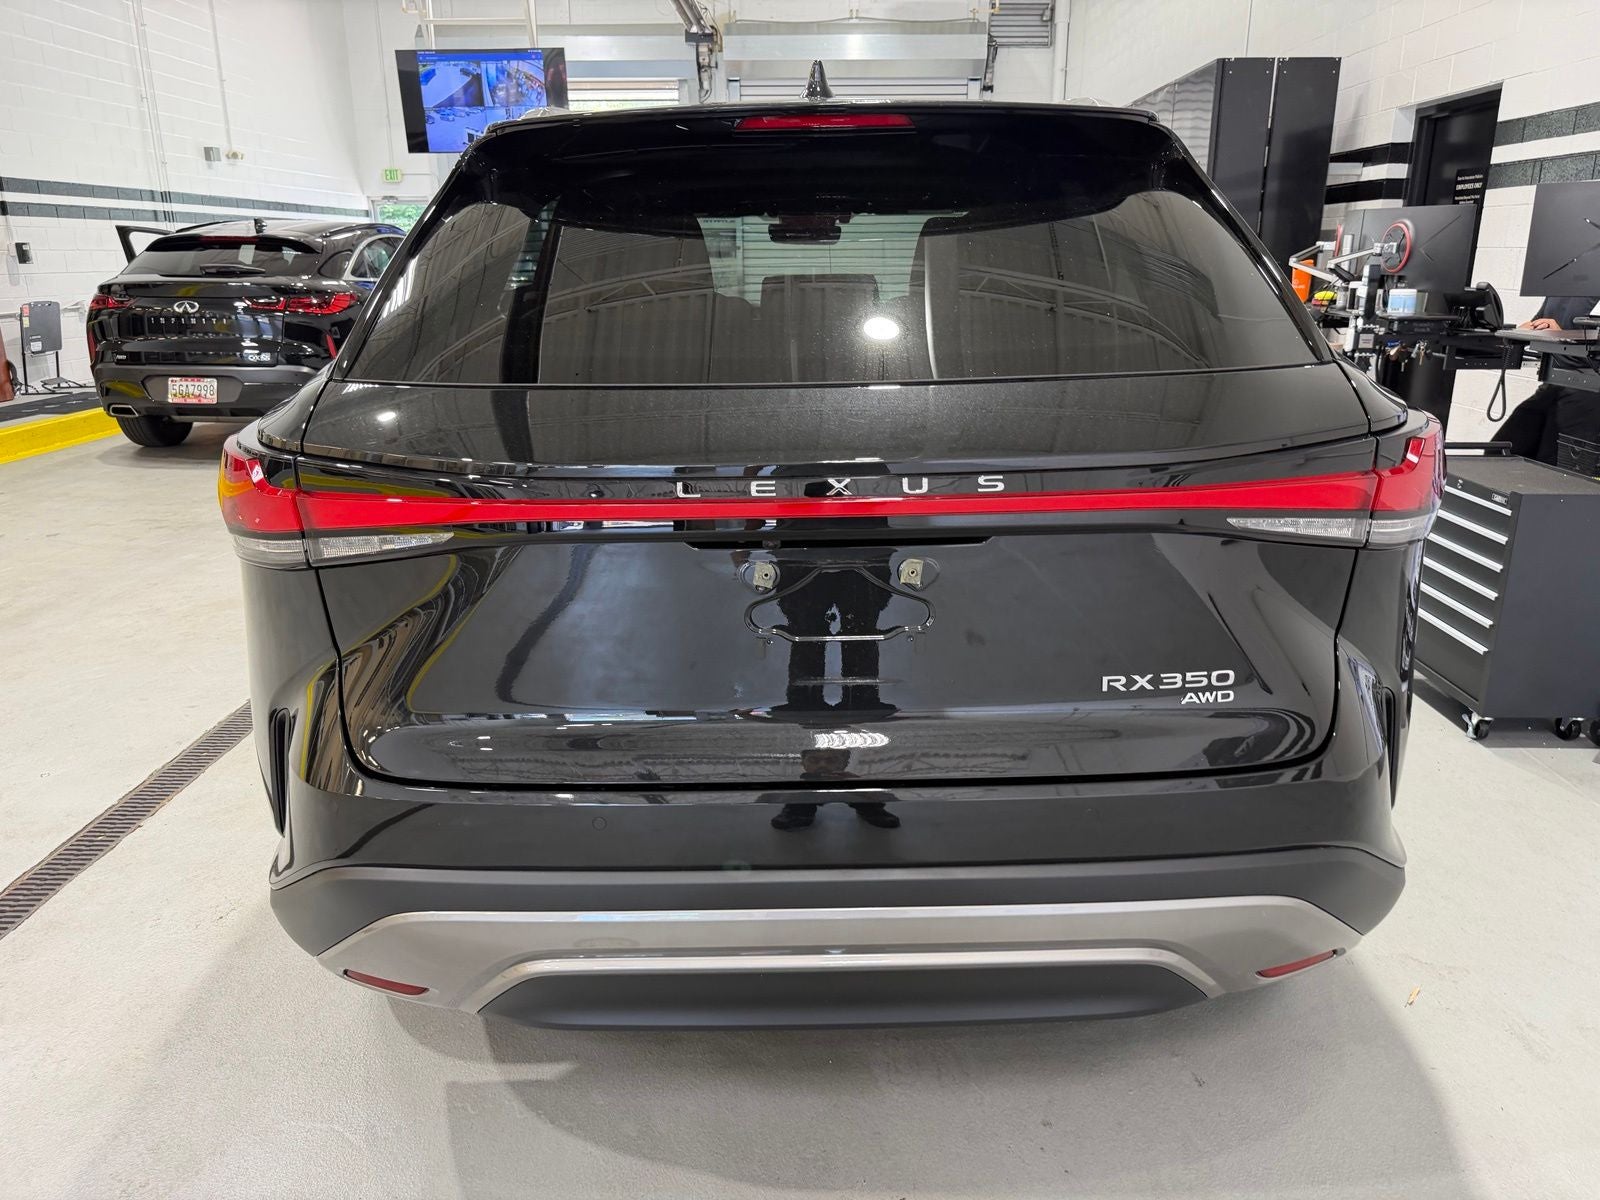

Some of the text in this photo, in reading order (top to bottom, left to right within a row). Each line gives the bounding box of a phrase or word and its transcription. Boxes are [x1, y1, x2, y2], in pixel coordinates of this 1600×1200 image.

[385, 169, 399, 181] EXIT
[1455, 181, 1483, 191] EMPLOYEES ONLY
[151, 317, 227, 325] INFINITI
[171, 383, 215, 397] 5GA7998
[676, 474, 1005, 499] LEXUS
[1180, 690, 1235, 704] AWD
